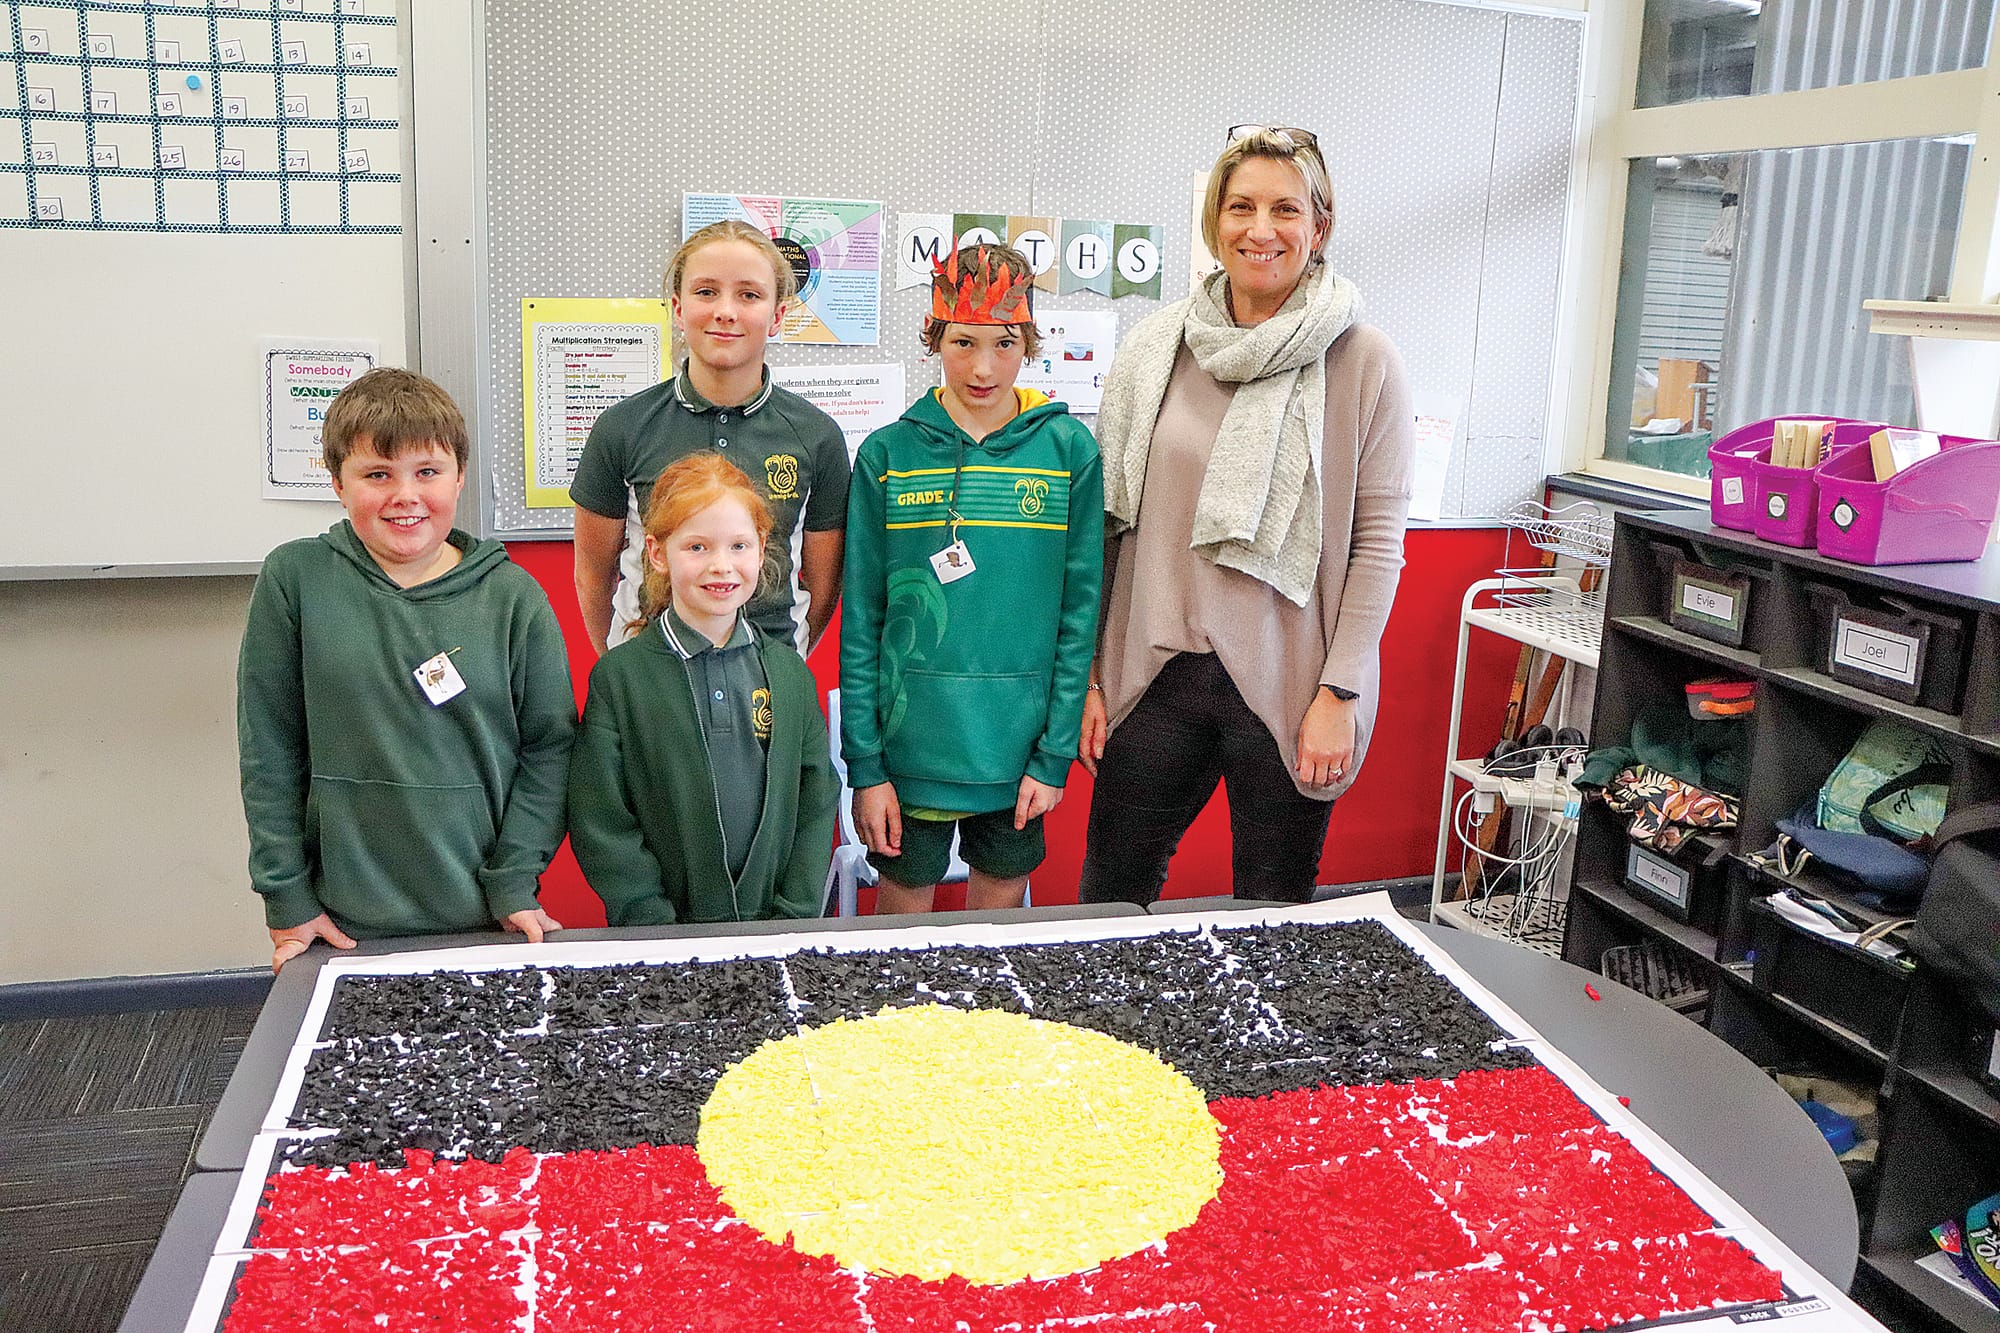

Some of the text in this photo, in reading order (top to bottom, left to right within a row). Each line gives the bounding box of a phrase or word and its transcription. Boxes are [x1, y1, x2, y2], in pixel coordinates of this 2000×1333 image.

[348, 1, 357, 10] 7
[29, 34, 41, 47] 9
[94, 42, 107, 53] 10
[225, 47, 237, 59] 12
[164, 49, 170, 59] 11
[288, 49, 299, 60] 13
[351, 51, 365, 61] 14
[34, 94, 47, 105] 16
[97, 99, 109, 109] 17
[162, 100, 174, 111] 18
[228, 103, 239, 114] 19
[286, 102, 305, 113] 20
[351, 104, 363, 115] 21
[35, 150, 54, 161] 23
[95, 151, 114, 162] 24
[161, 152, 182, 164] 25
[222, 155, 241, 167] 26
[287, 157, 306, 167] 27
[347, 156, 366, 168] 28
[39, 204, 59, 215] 30
[551, 336, 643, 346] Multiplication Strategies
[288, 363, 352, 378] Somebody
[775, 379, 805, 388] students
[806, 378, 826, 387] when
[826, 377, 842, 387] they
[855, 377, 874, 386] given
[290, 386, 342, 398] WANTE
[826, 390, 834, 398] to
[834, 389, 852, 398] solve
[837, 401, 848, 409] you
[308, 407, 327, 421] Bu
[897, 489, 945, 506] GRADE
[1696, 593, 1716, 608] Evie
[1862, 642, 1887, 660] Joel
[1650, 867, 1669, 885] Finn
